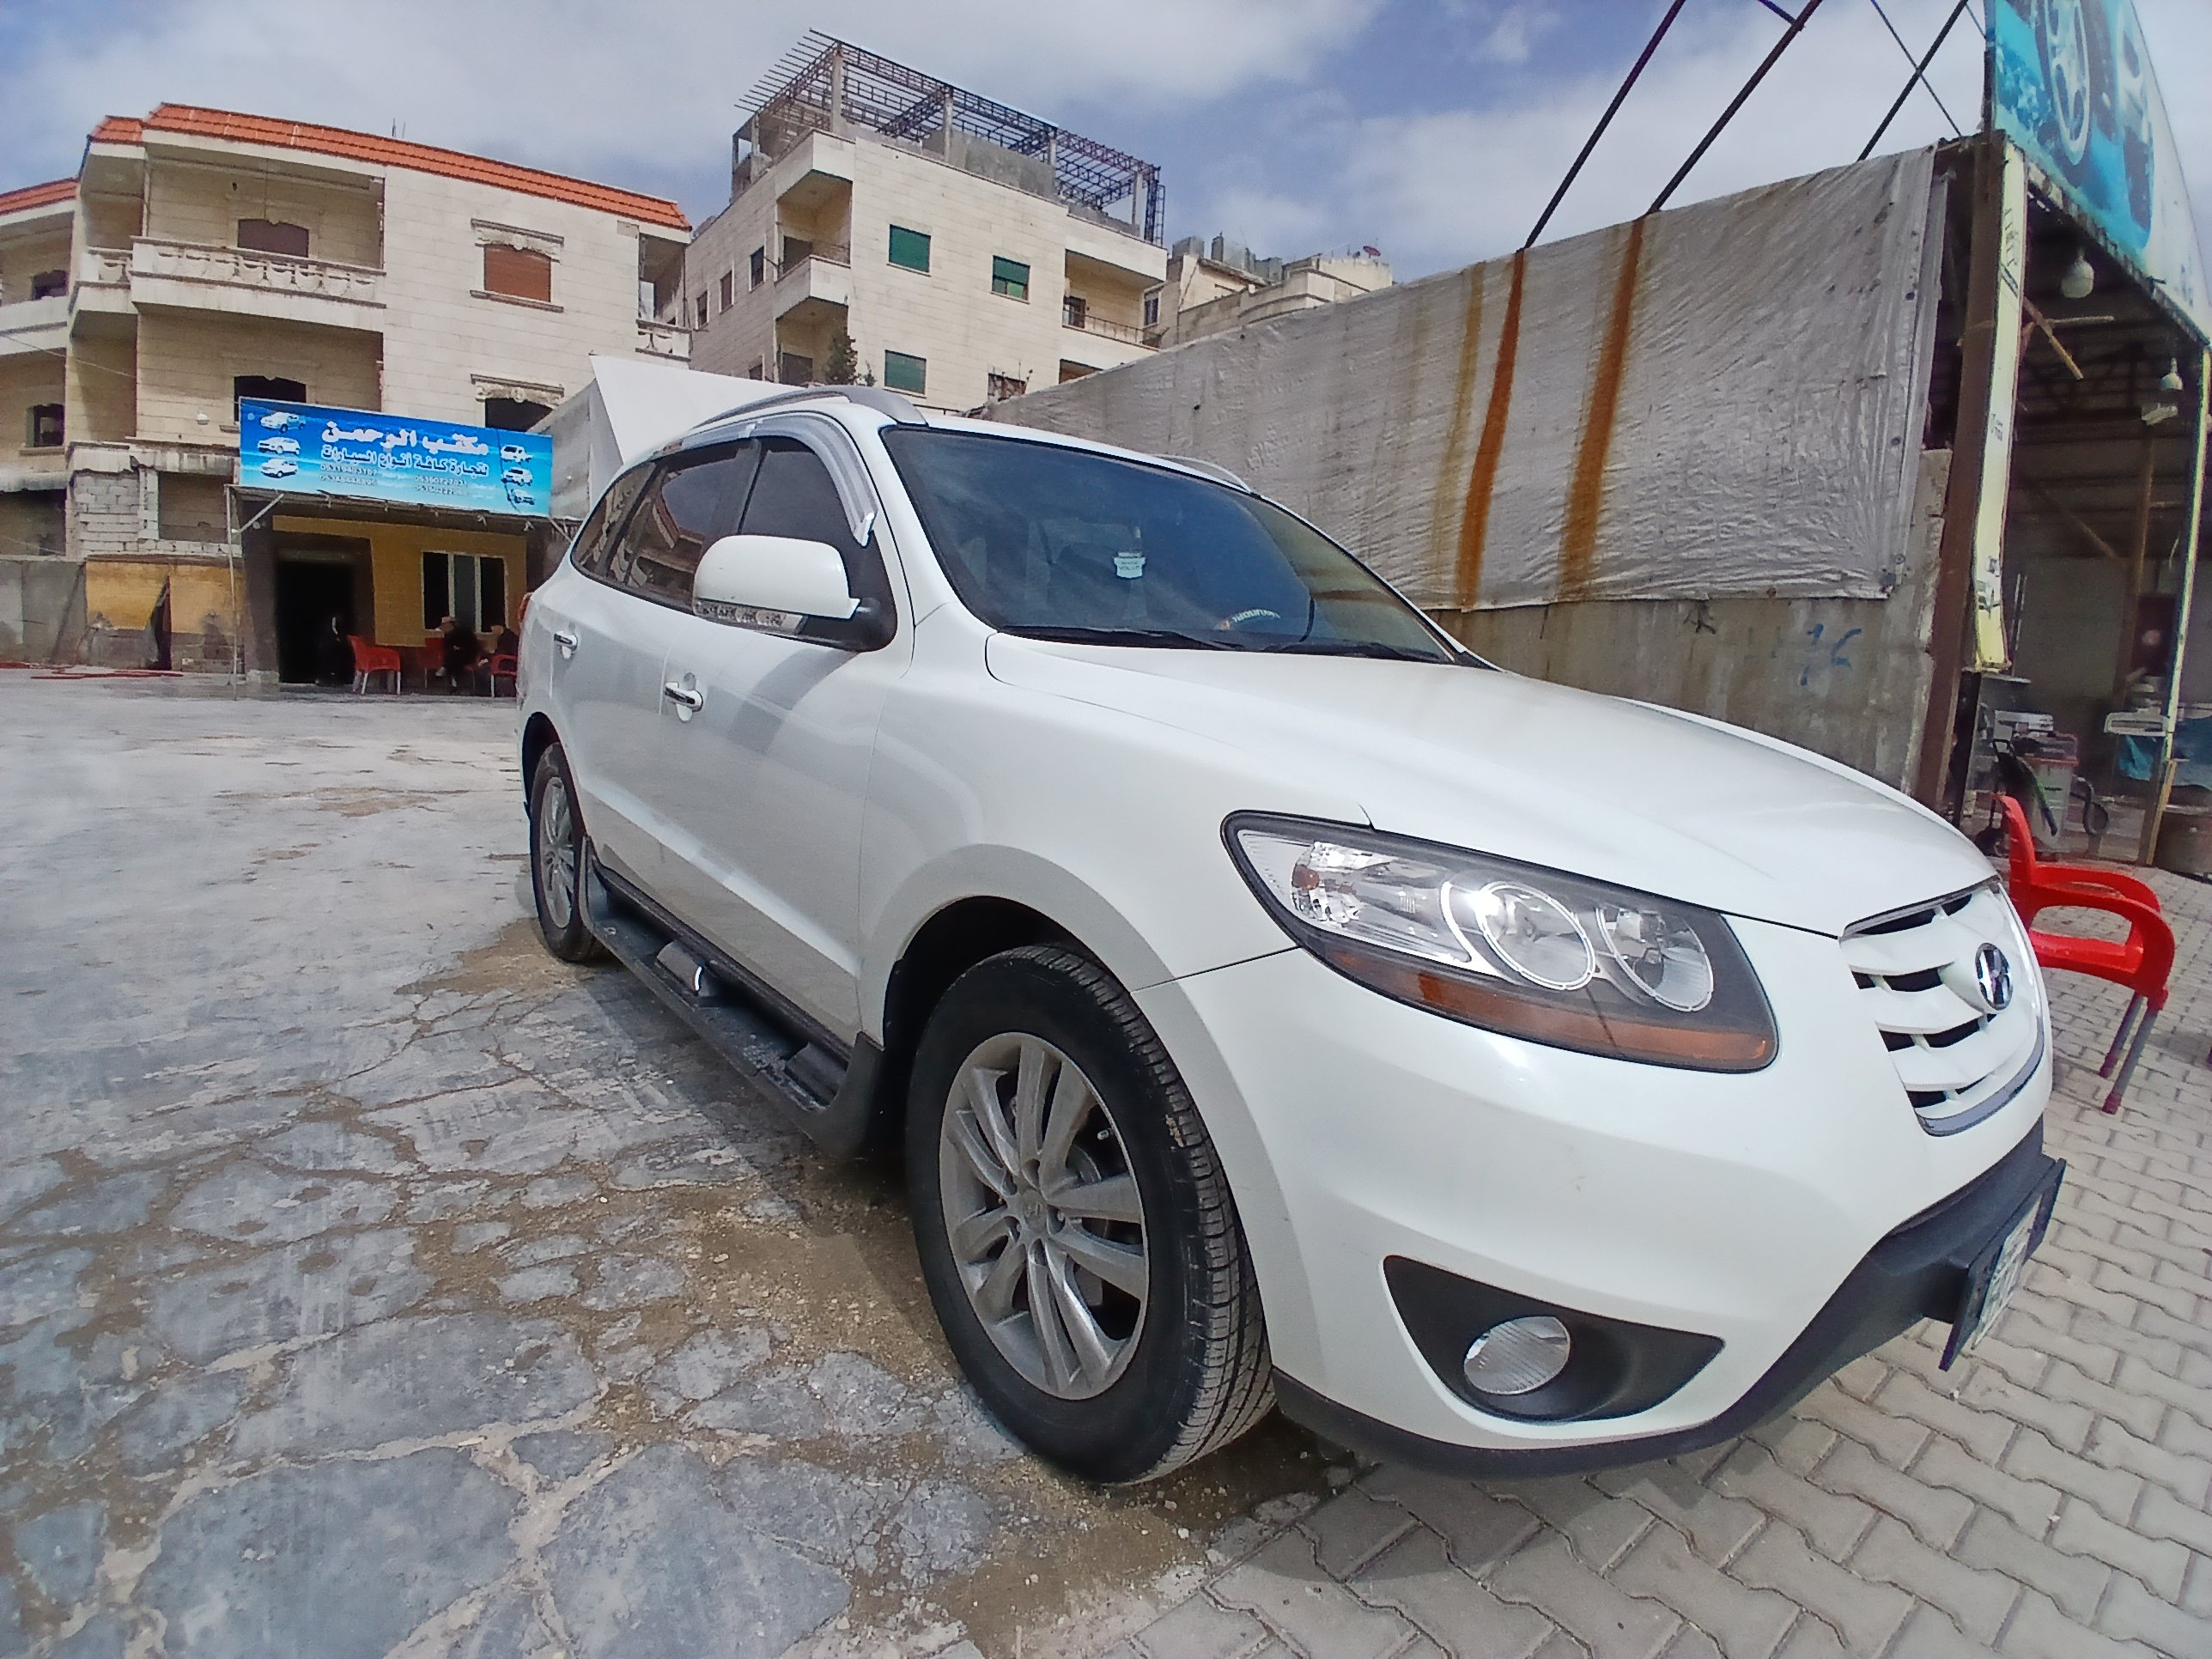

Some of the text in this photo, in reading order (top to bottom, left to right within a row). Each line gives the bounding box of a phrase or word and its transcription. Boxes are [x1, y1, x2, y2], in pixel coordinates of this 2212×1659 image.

[422, 432, 489, 456] مكتب
[321, 444, 378, 464] السيارات
[413, 454, 448, 472] كافة
[448, 459, 489, 478] لتجارة
